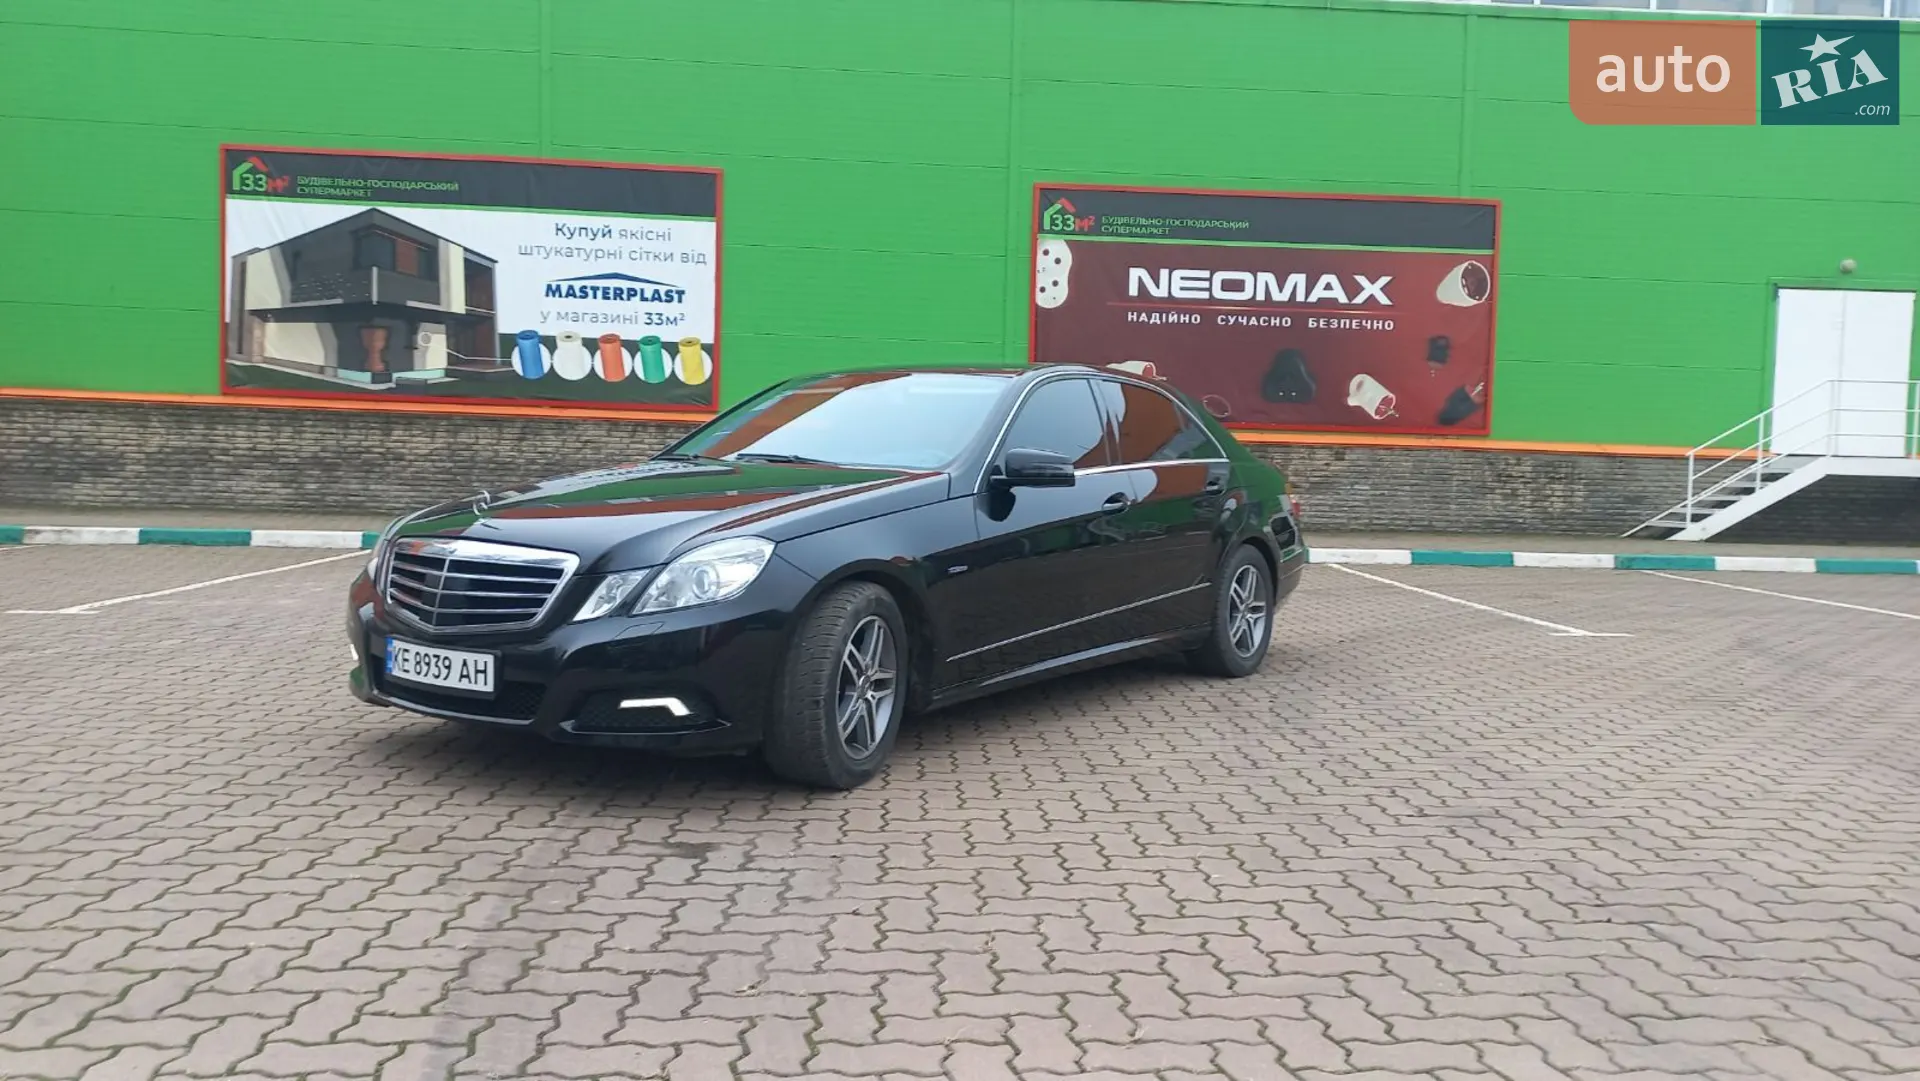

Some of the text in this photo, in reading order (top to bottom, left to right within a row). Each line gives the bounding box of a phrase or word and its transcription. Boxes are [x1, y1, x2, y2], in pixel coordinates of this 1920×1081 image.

[297, 186, 372, 197] СУПЕРМАРКЕТ
[554, 222, 672, 242] Купуй якісні
[1102, 225, 1171, 235] СУПЕРМАРКЕТ
[517, 243, 707, 265] штукатурні сітки від
[545, 283, 686, 304] MASTERPLAST
[1128, 267, 1394, 306] NEOMAX
[540, 311, 551, 324] у
[556, 309, 639, 325] магазині
[1127, 311, 1395, 331] НАДІЙНО СУЧАСНО БЕЗПЕЧНО
[394, 647, 488, 686] KE 8939 AH
